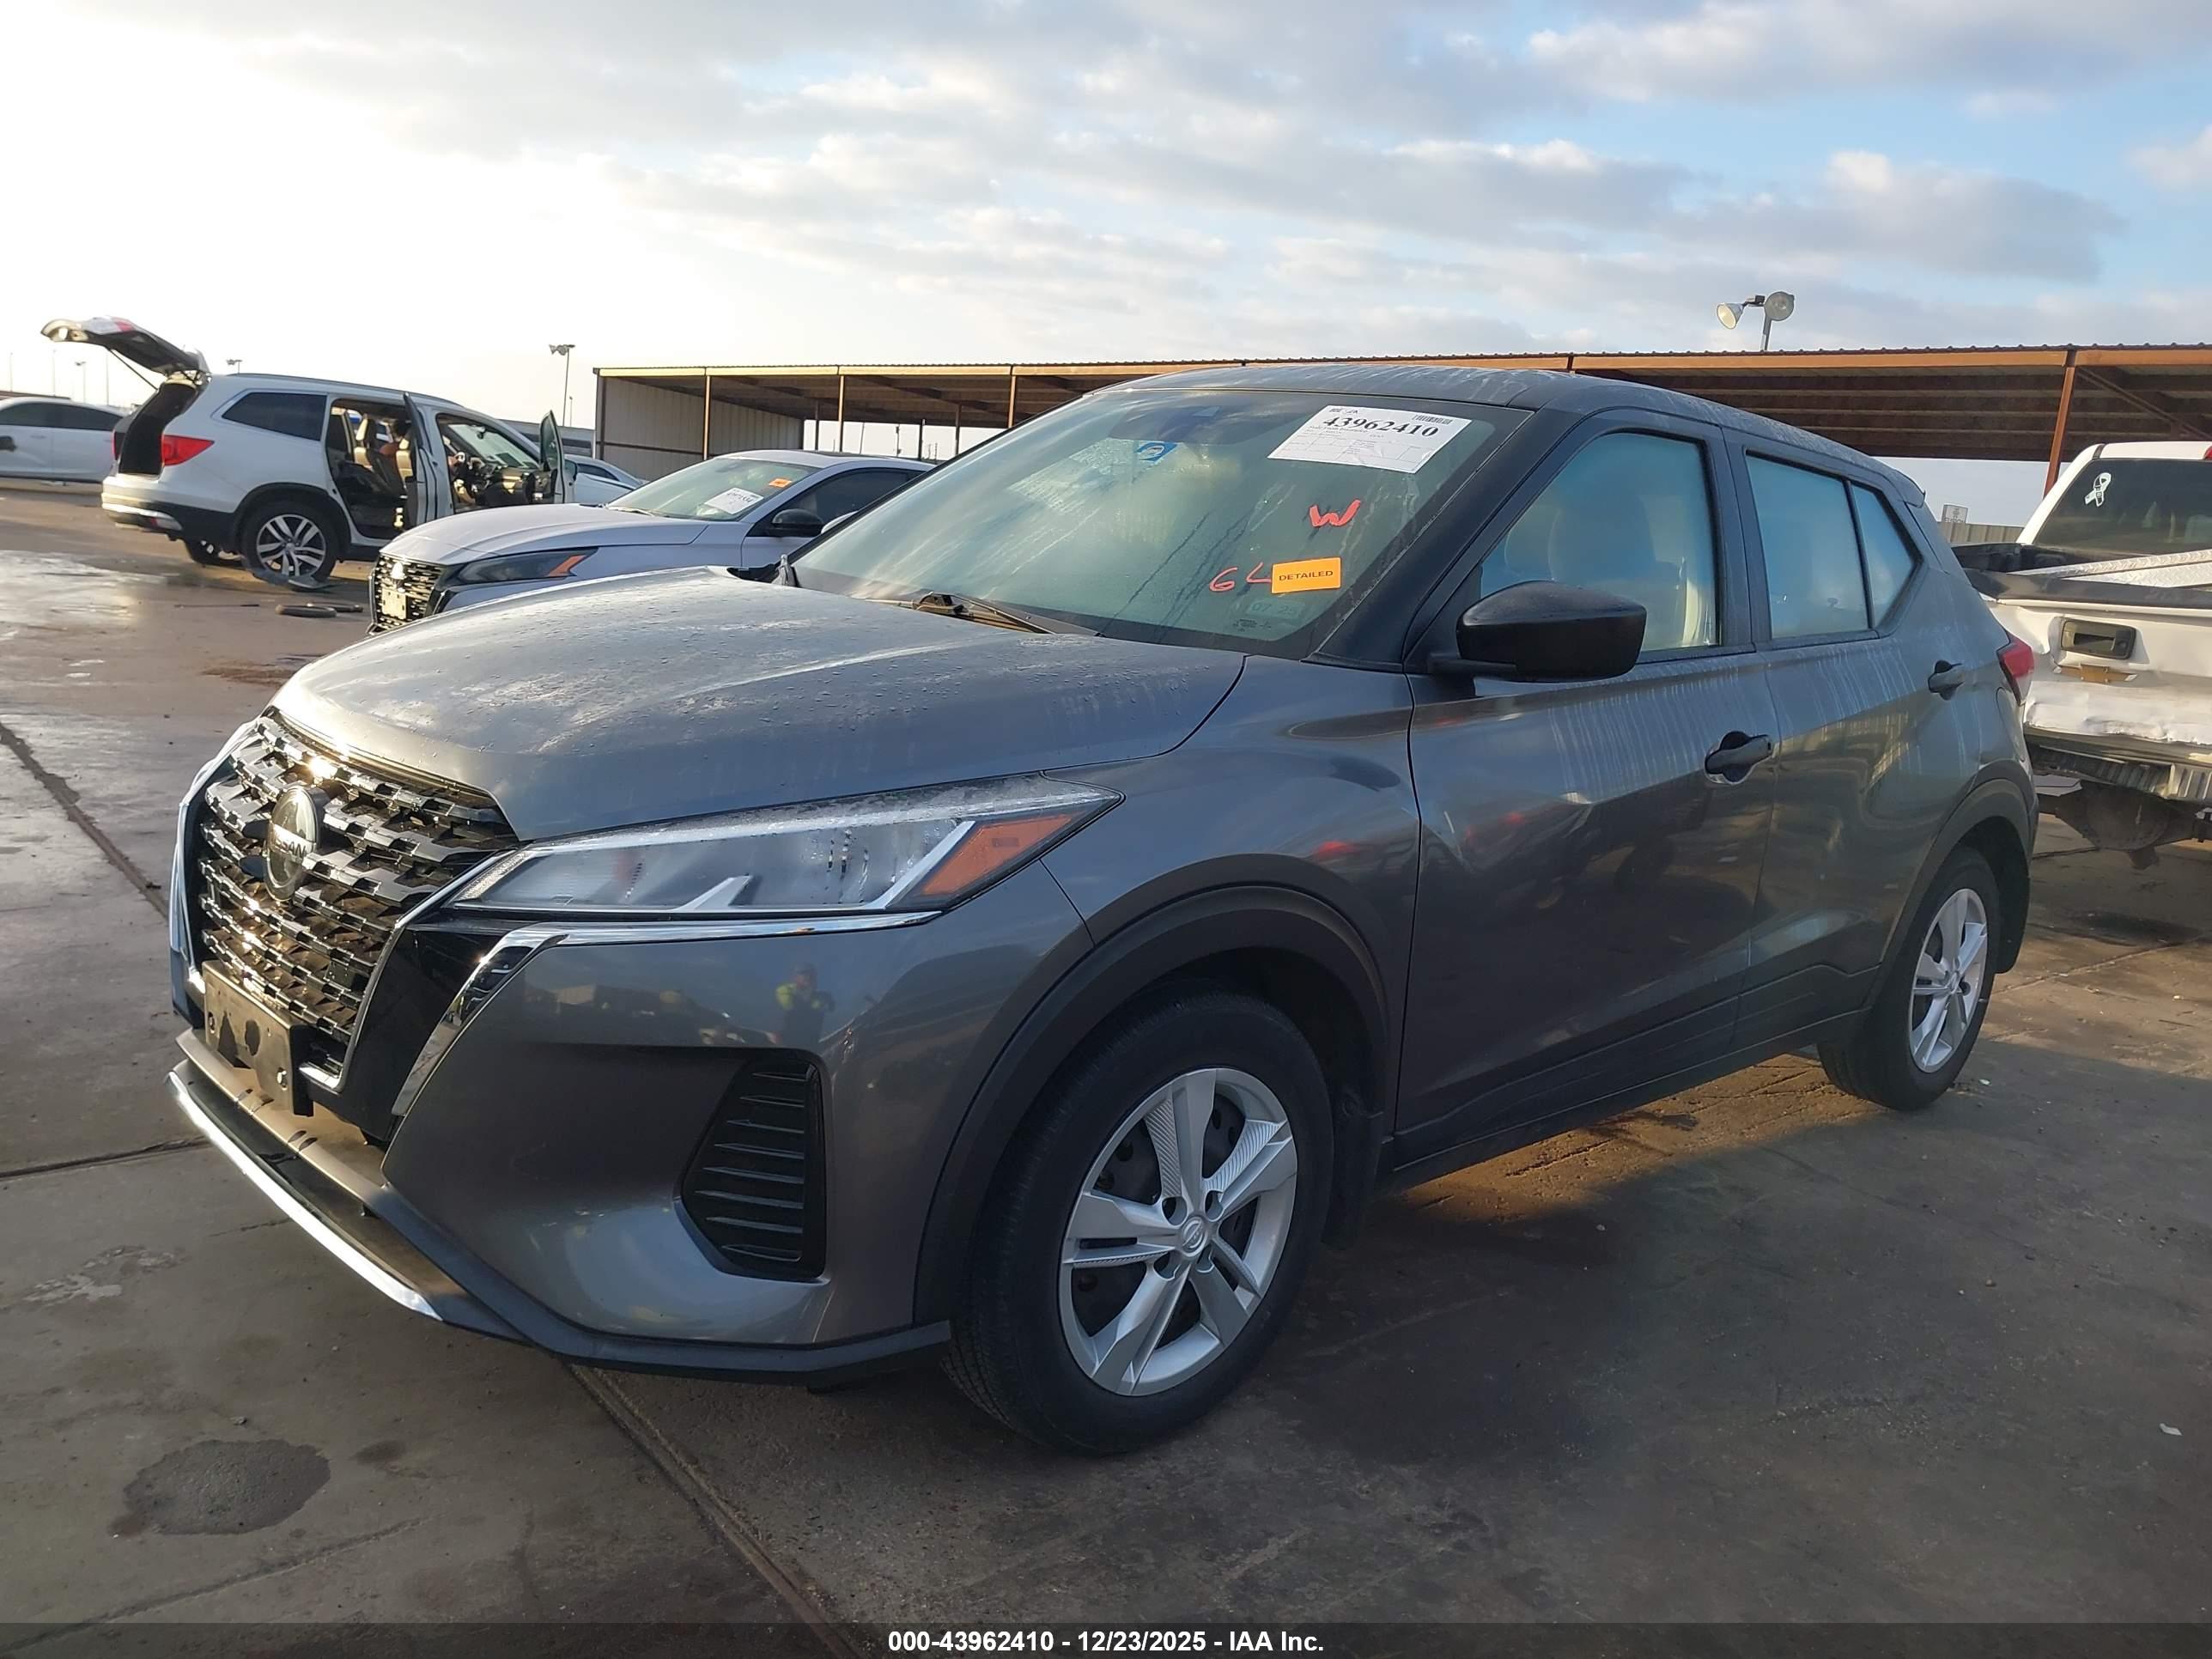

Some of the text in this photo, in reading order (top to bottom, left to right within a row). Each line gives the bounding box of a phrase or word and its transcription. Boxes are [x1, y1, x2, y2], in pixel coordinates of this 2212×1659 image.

[1323, 416, 1439, 437] 43962410
[1309, 498, 1362, 528] W
[1278, 569, 1334, 582] DETAILED
